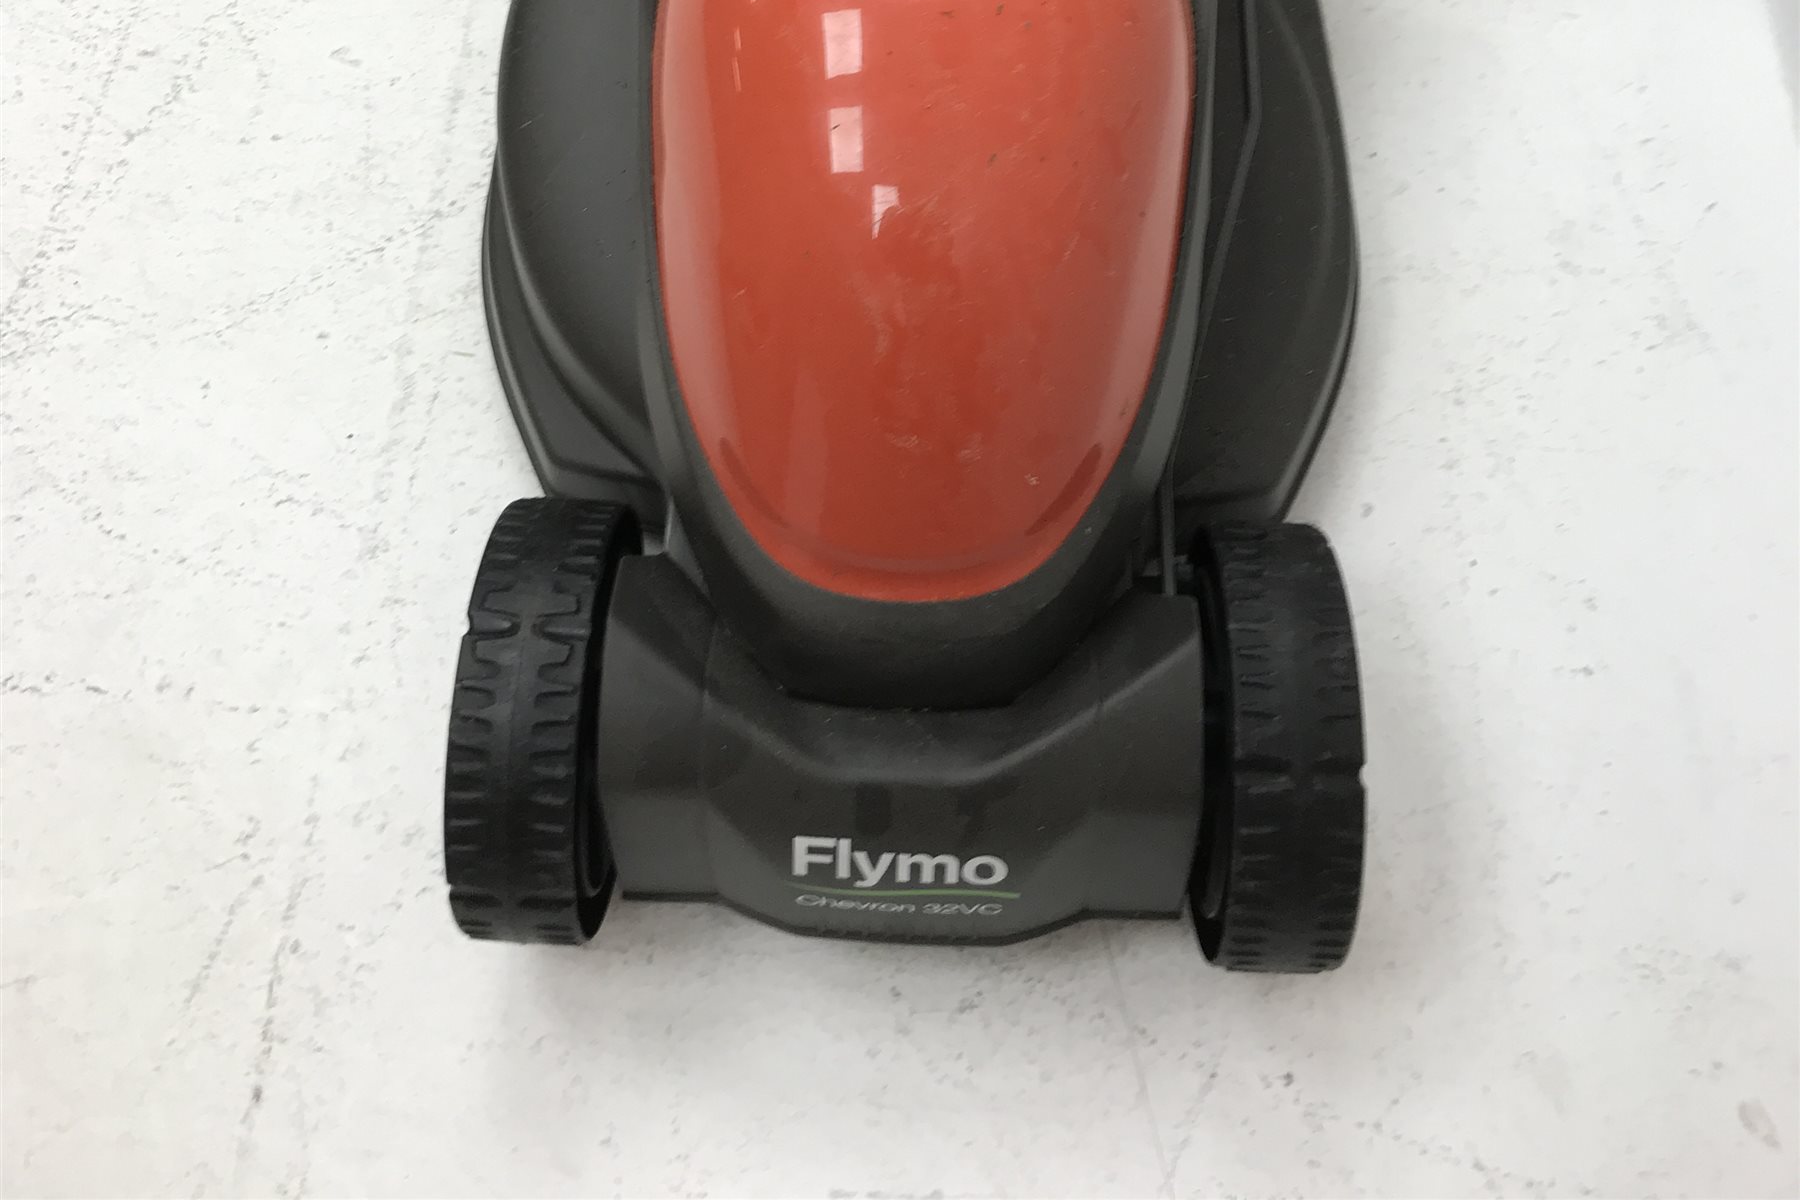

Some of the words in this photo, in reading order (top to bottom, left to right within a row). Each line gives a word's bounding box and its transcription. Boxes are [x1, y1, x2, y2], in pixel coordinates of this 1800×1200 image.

[791, 835, 1010, 888] Flymo
[795, 893, 916, 914] Chevron
[922, 902, 1004, 916] 32VC
